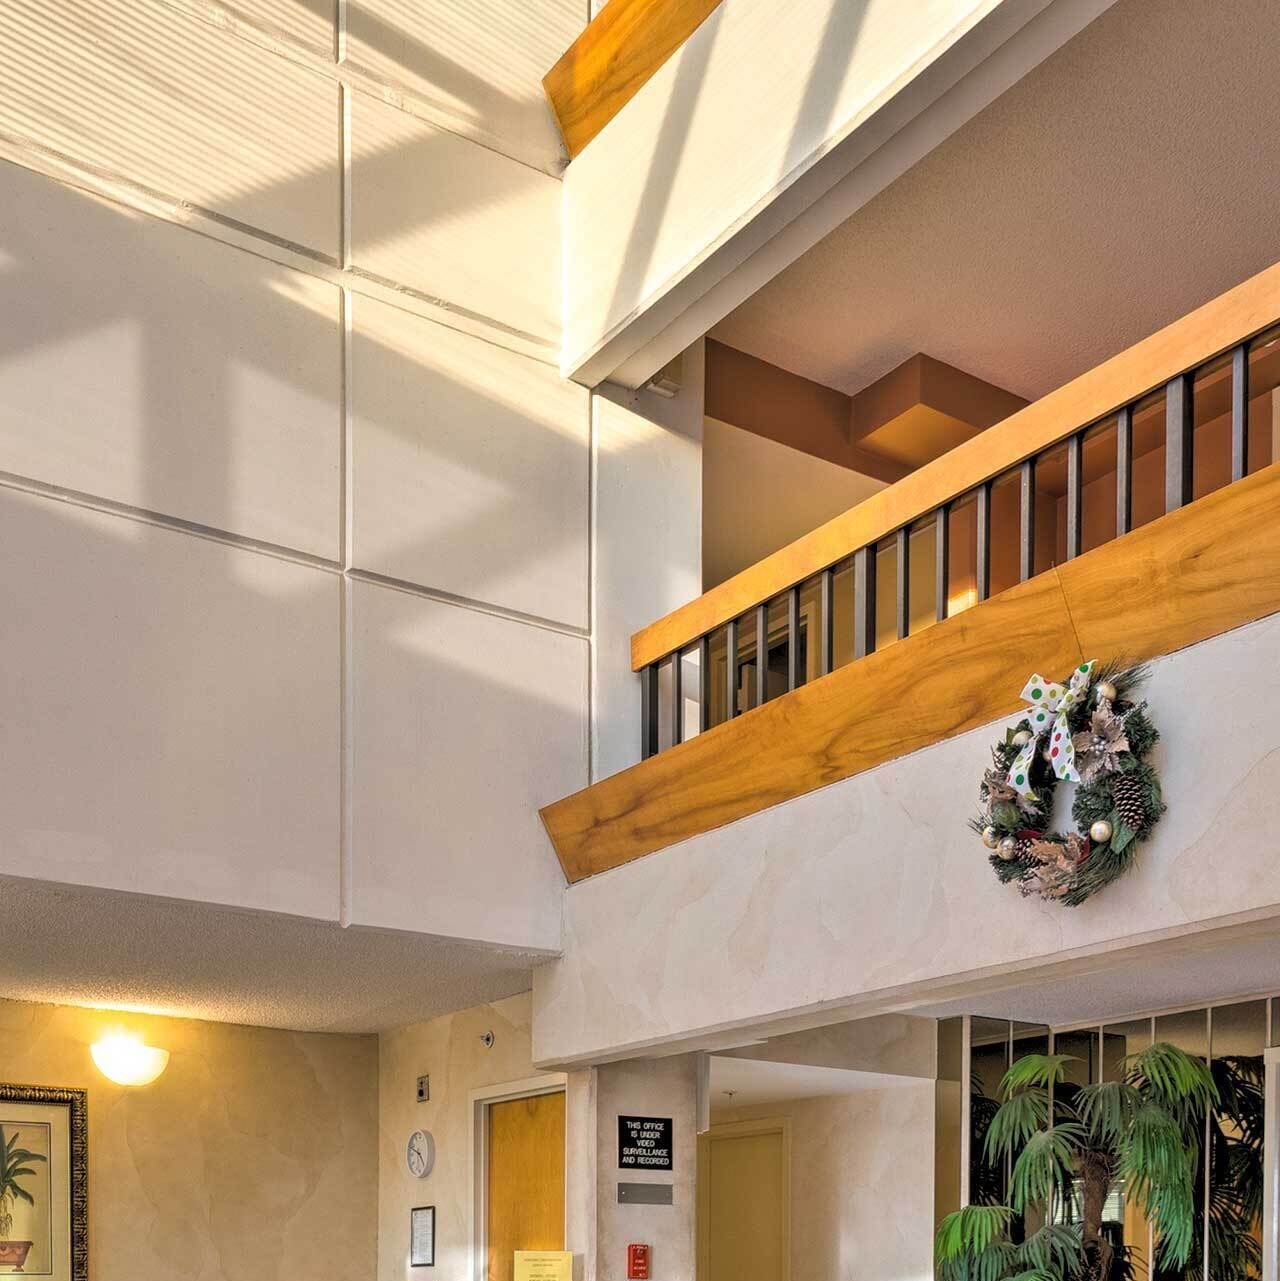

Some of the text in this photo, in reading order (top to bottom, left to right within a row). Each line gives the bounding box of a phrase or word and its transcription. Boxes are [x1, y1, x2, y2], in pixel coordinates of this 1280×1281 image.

[626, 1121, 665, 1131] THIS OFFICE
[630, 1130, 661, 1139] IS UNDER
[636, 1139, 656, 1147] VIDEO
[622, 1147, 668, 1157] SURVEILLANCE
[622, 1156, 670, 1166] AND RECORDED
